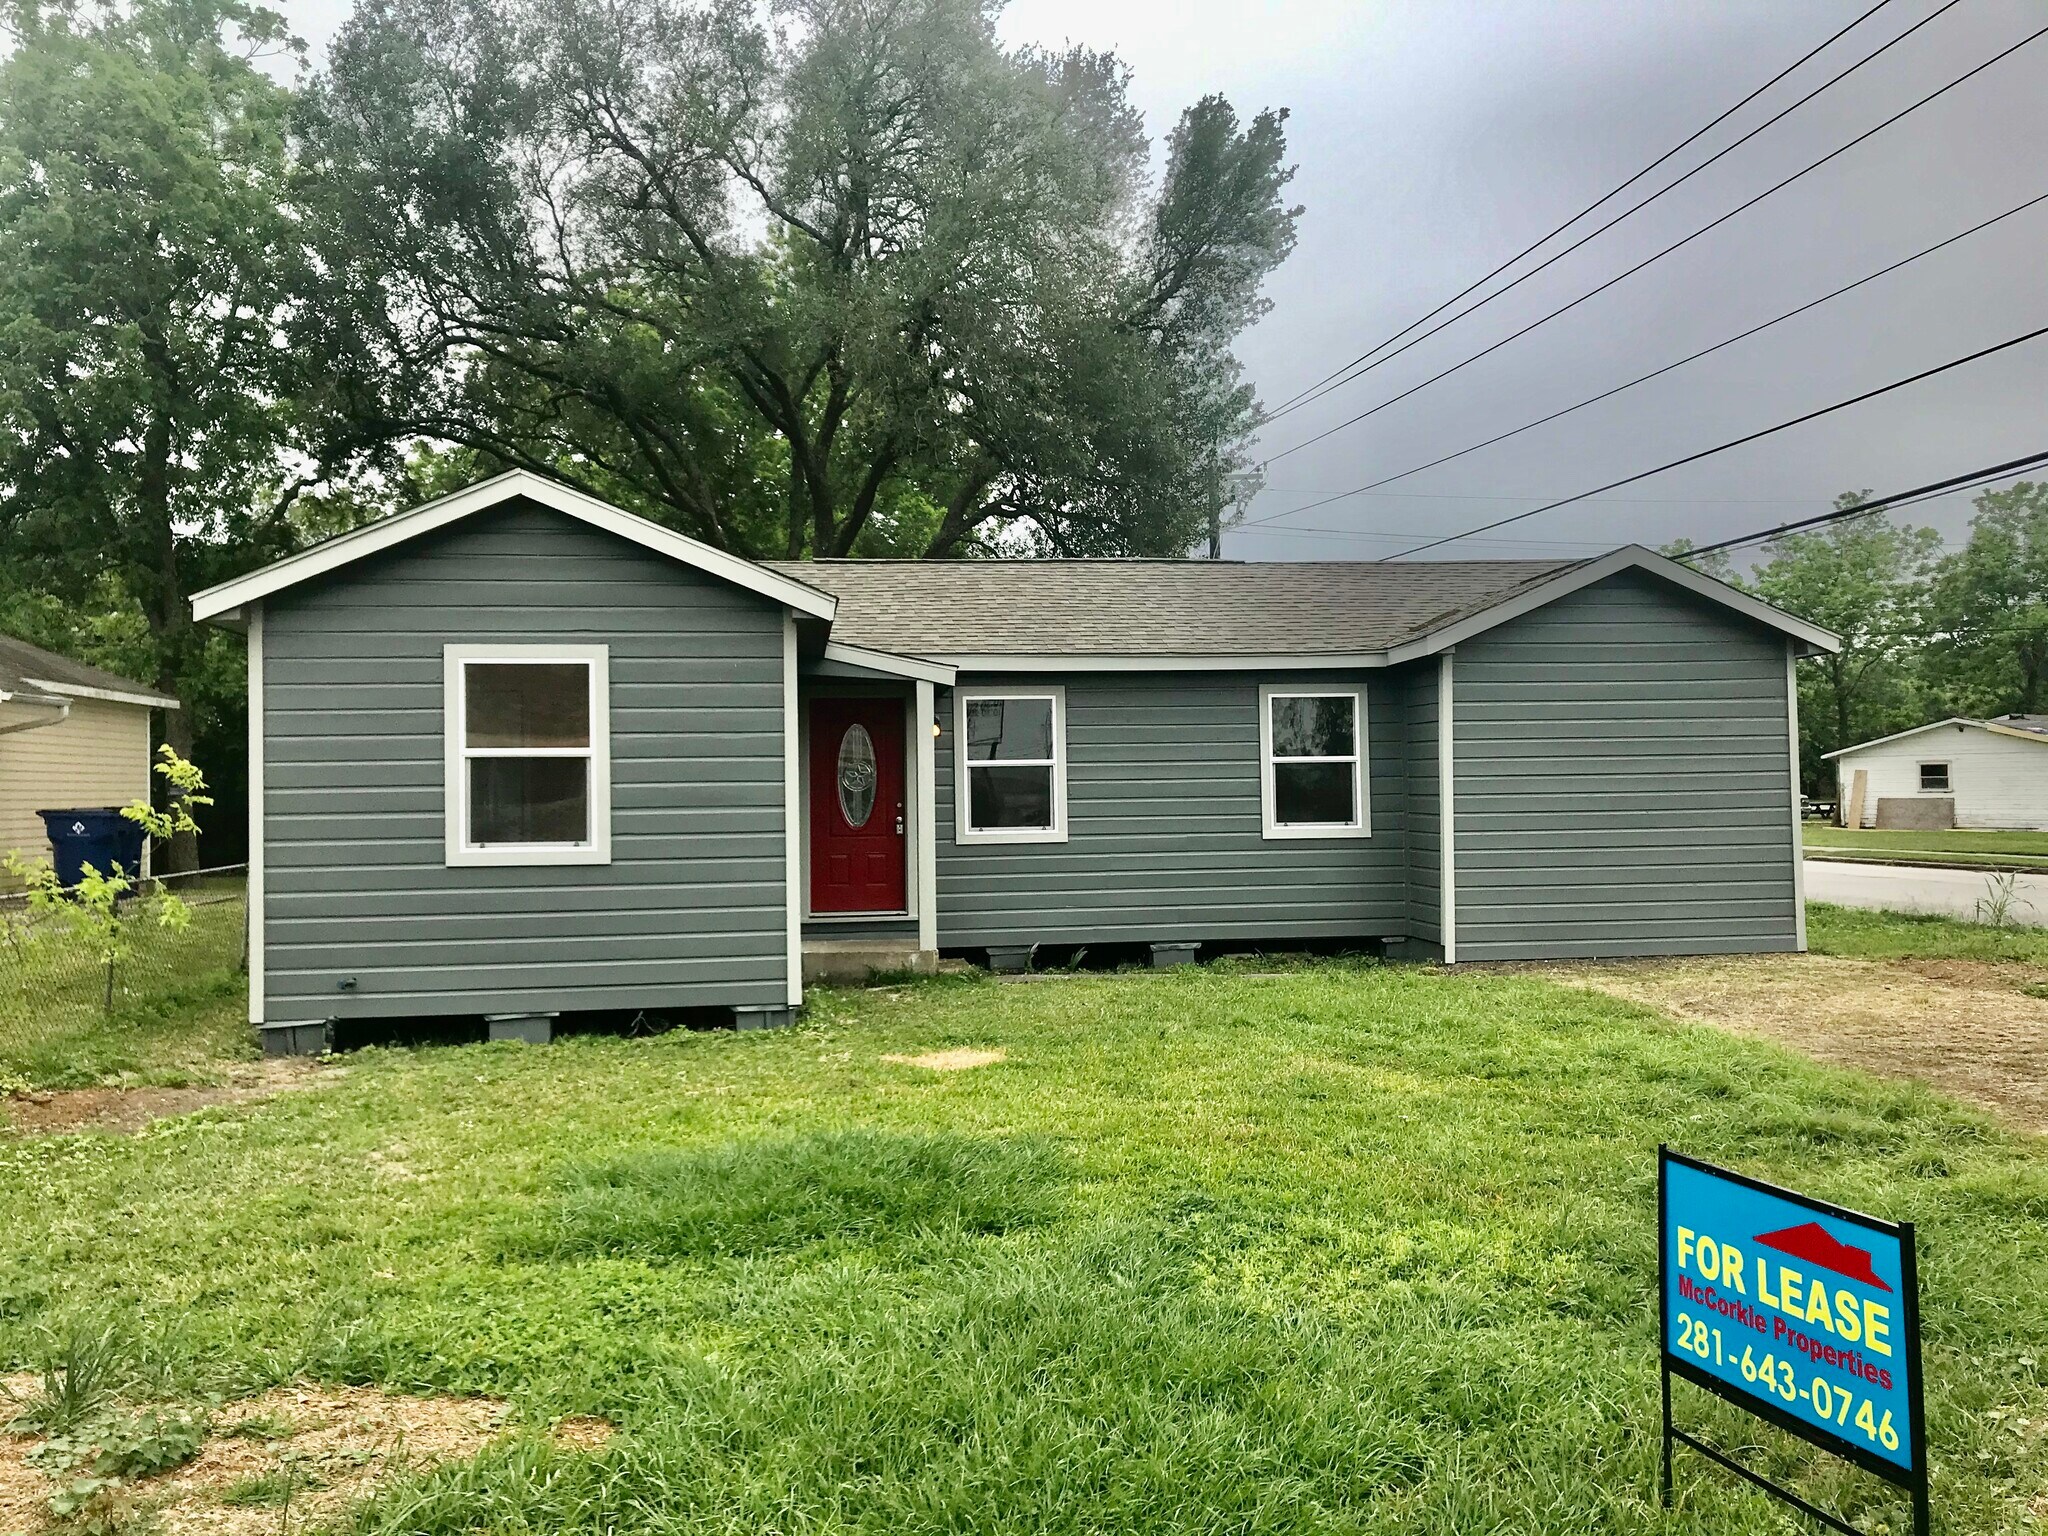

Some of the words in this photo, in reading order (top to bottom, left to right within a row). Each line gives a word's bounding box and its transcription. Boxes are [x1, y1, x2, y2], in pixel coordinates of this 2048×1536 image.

[1677, 1226, 1746, 1295] FOR
[1757, 1257, 1893, 1357] LEASE
[1678, 1274, 1767, 1333] McCorkle
[1773, 1316, 1893, 1391] Properties
[1677, 1312, 1899, 1450] 281-643-0746
